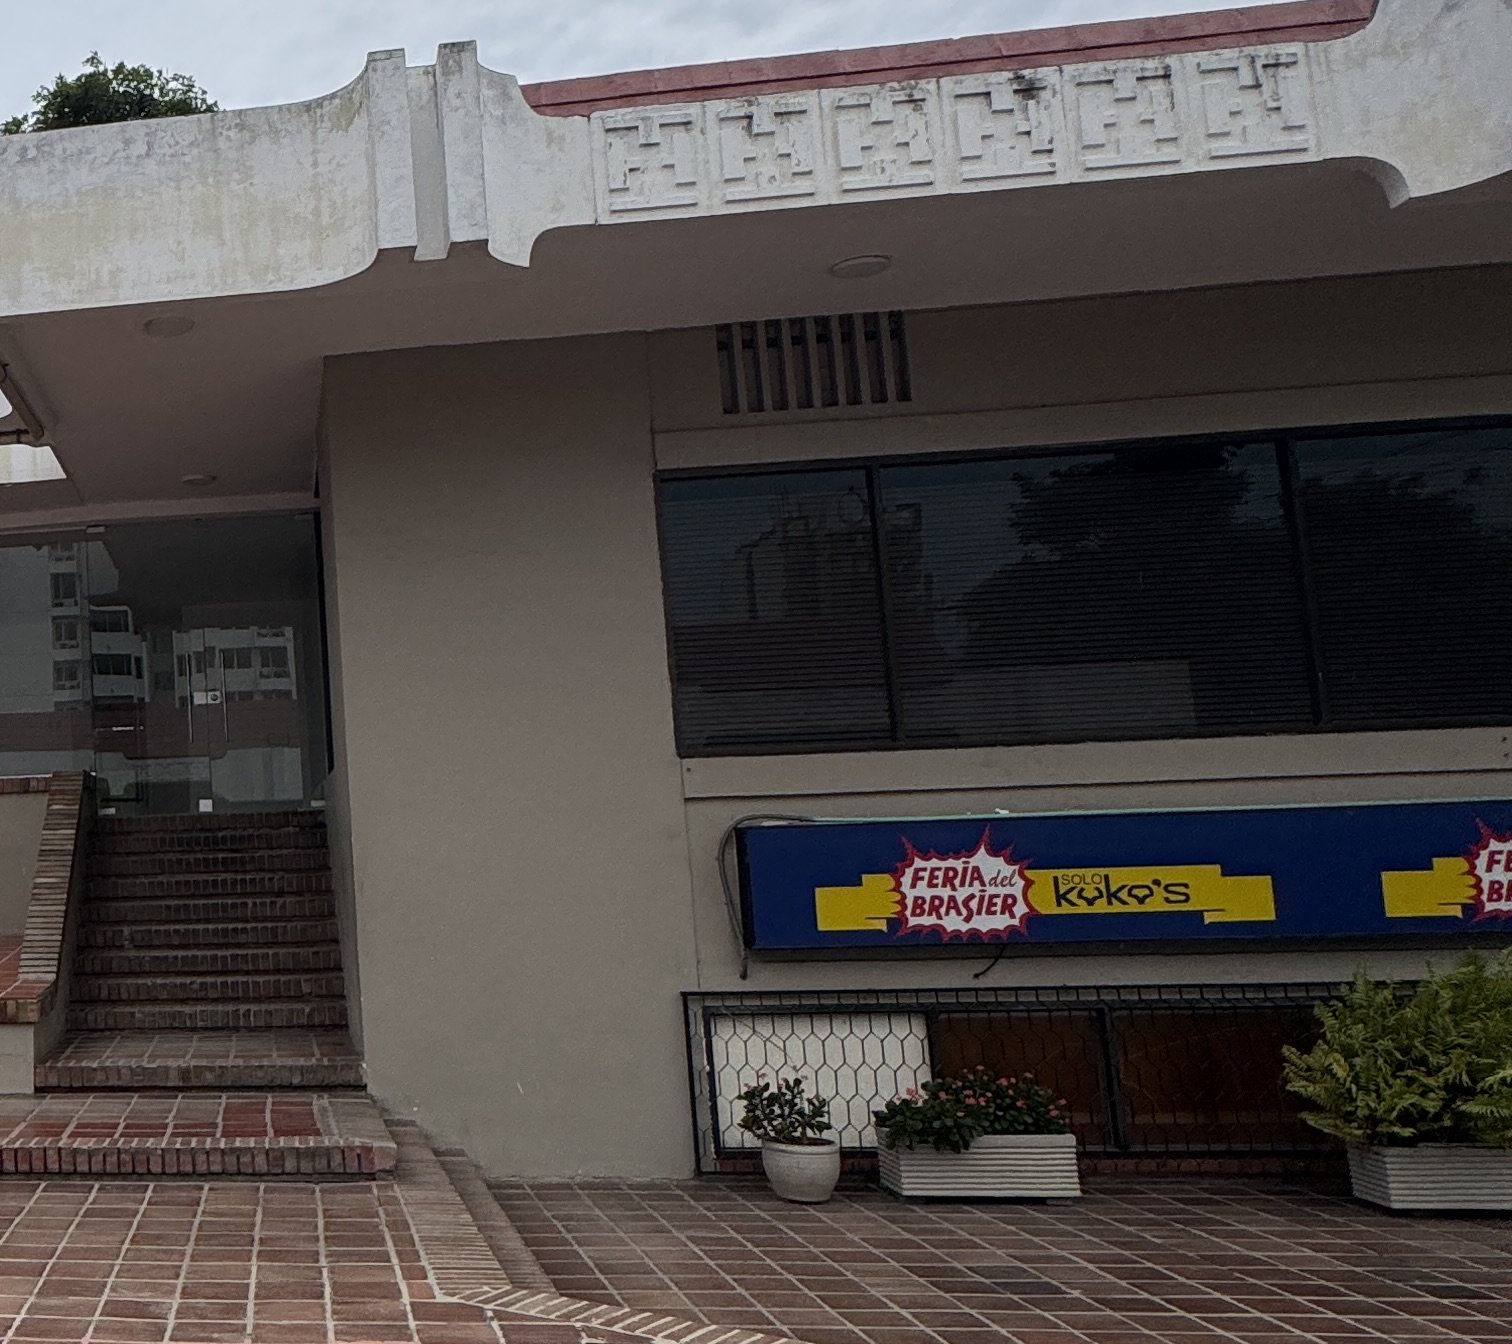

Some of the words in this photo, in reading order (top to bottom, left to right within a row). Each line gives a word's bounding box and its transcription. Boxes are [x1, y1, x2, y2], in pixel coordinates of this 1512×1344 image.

[909, 860, 986, 891] FERIA
[987, 871, 1018, 889] del
[1061, 872, 1104, 886] SOLO
[909, 889, 1018, 923] BRASIER
